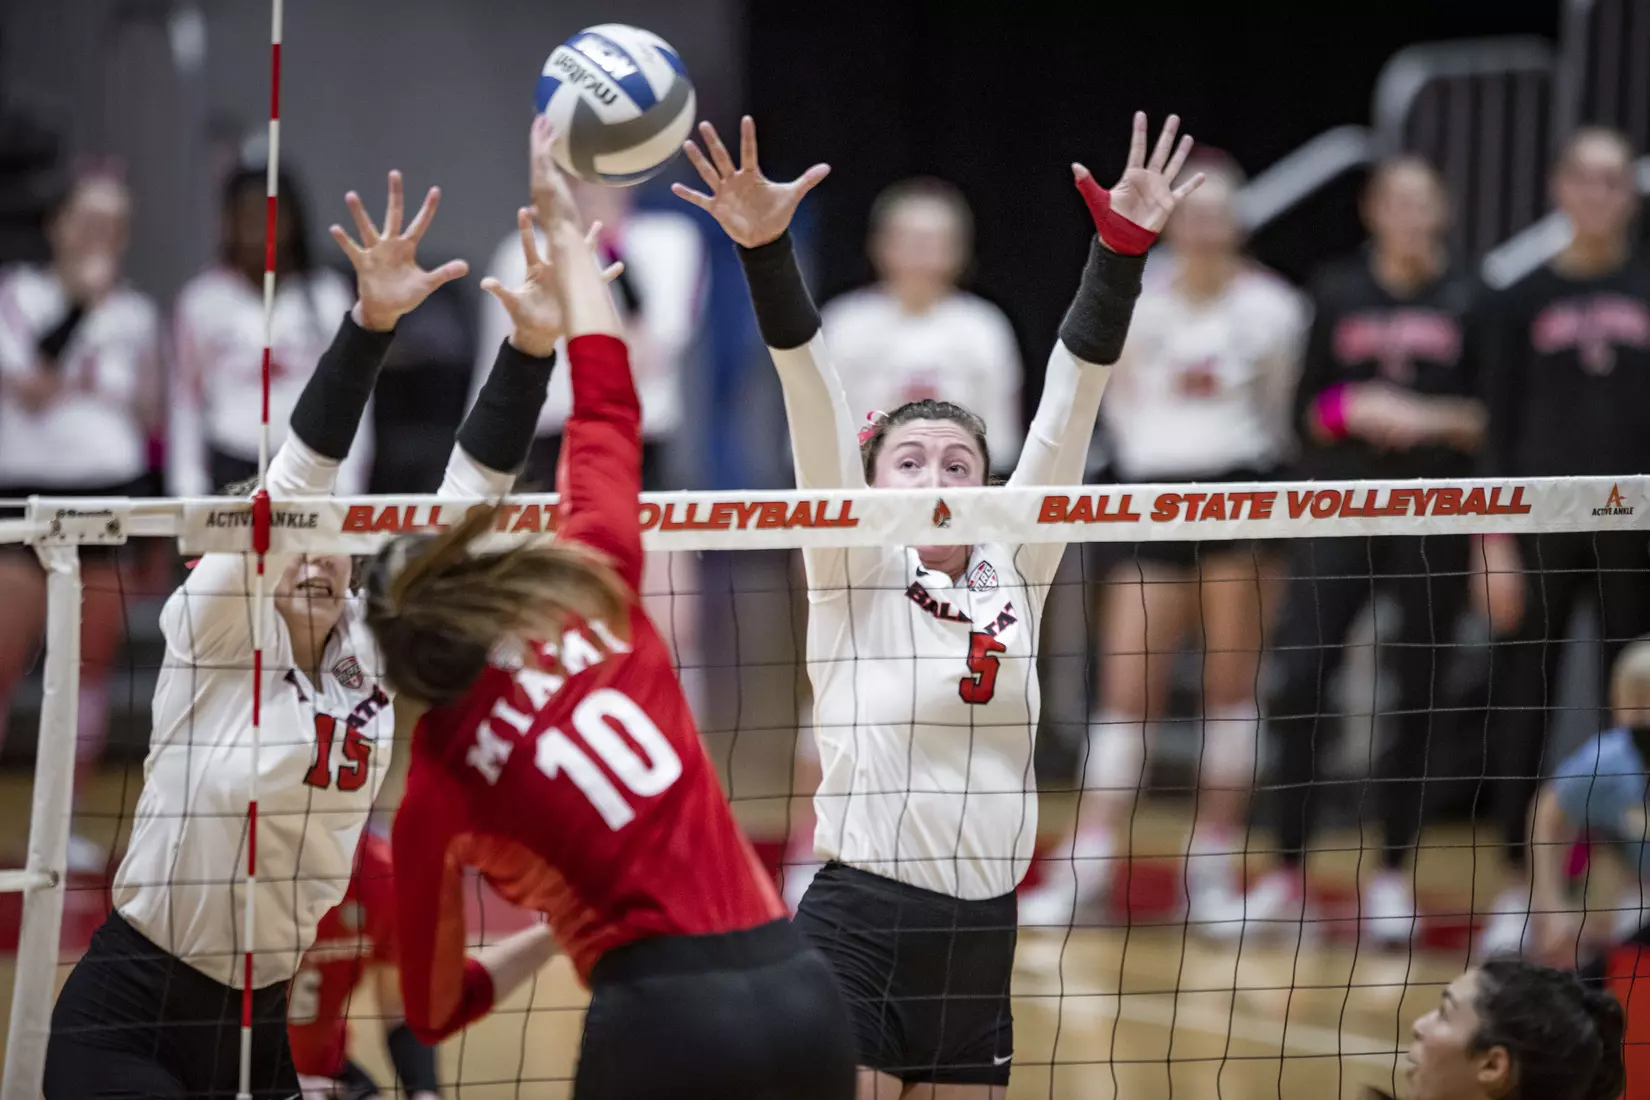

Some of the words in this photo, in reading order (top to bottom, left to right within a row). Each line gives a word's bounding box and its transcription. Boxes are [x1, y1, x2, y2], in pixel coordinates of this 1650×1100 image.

[341, 505, 451, 533] BALL
[639, 500, 859, 531] OLLEYBALL
[1037, 495, 1141, 523] BALL
[1150, 492, 1277, 522] STATE
[1287, 486, 1532, 519] VOLLEYBALL
[1591, 507, 1613, 516] ACTIVE
[1612, 506, 1635, 516] ANKLE
[958, 631, 1007, 704] 5
[303, 713, 372, 791] 15
[534, 687, 683, 831] 10
